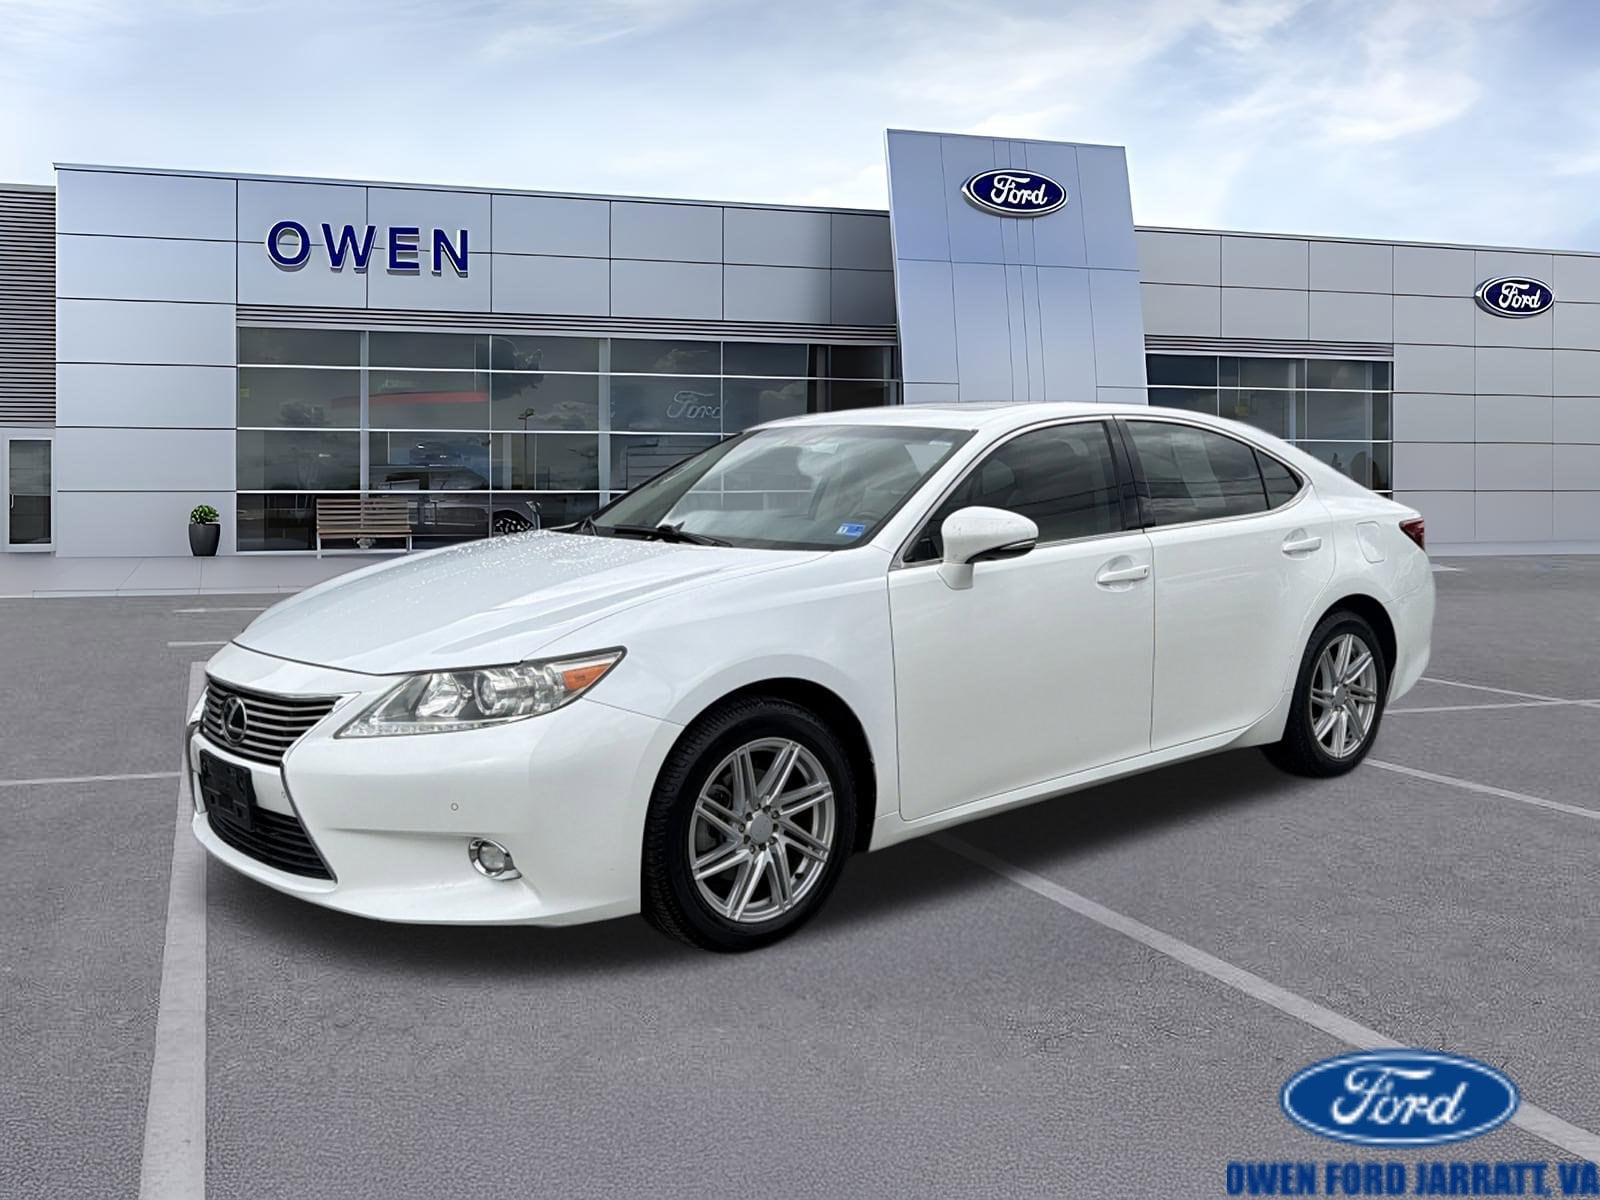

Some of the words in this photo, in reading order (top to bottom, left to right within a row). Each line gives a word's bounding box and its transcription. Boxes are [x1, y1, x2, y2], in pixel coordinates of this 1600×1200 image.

[990, 174, 1048, 206] Ford
[266, 220, 469, 276] OWEN
[1498, 282, 1542, 309] Ford
